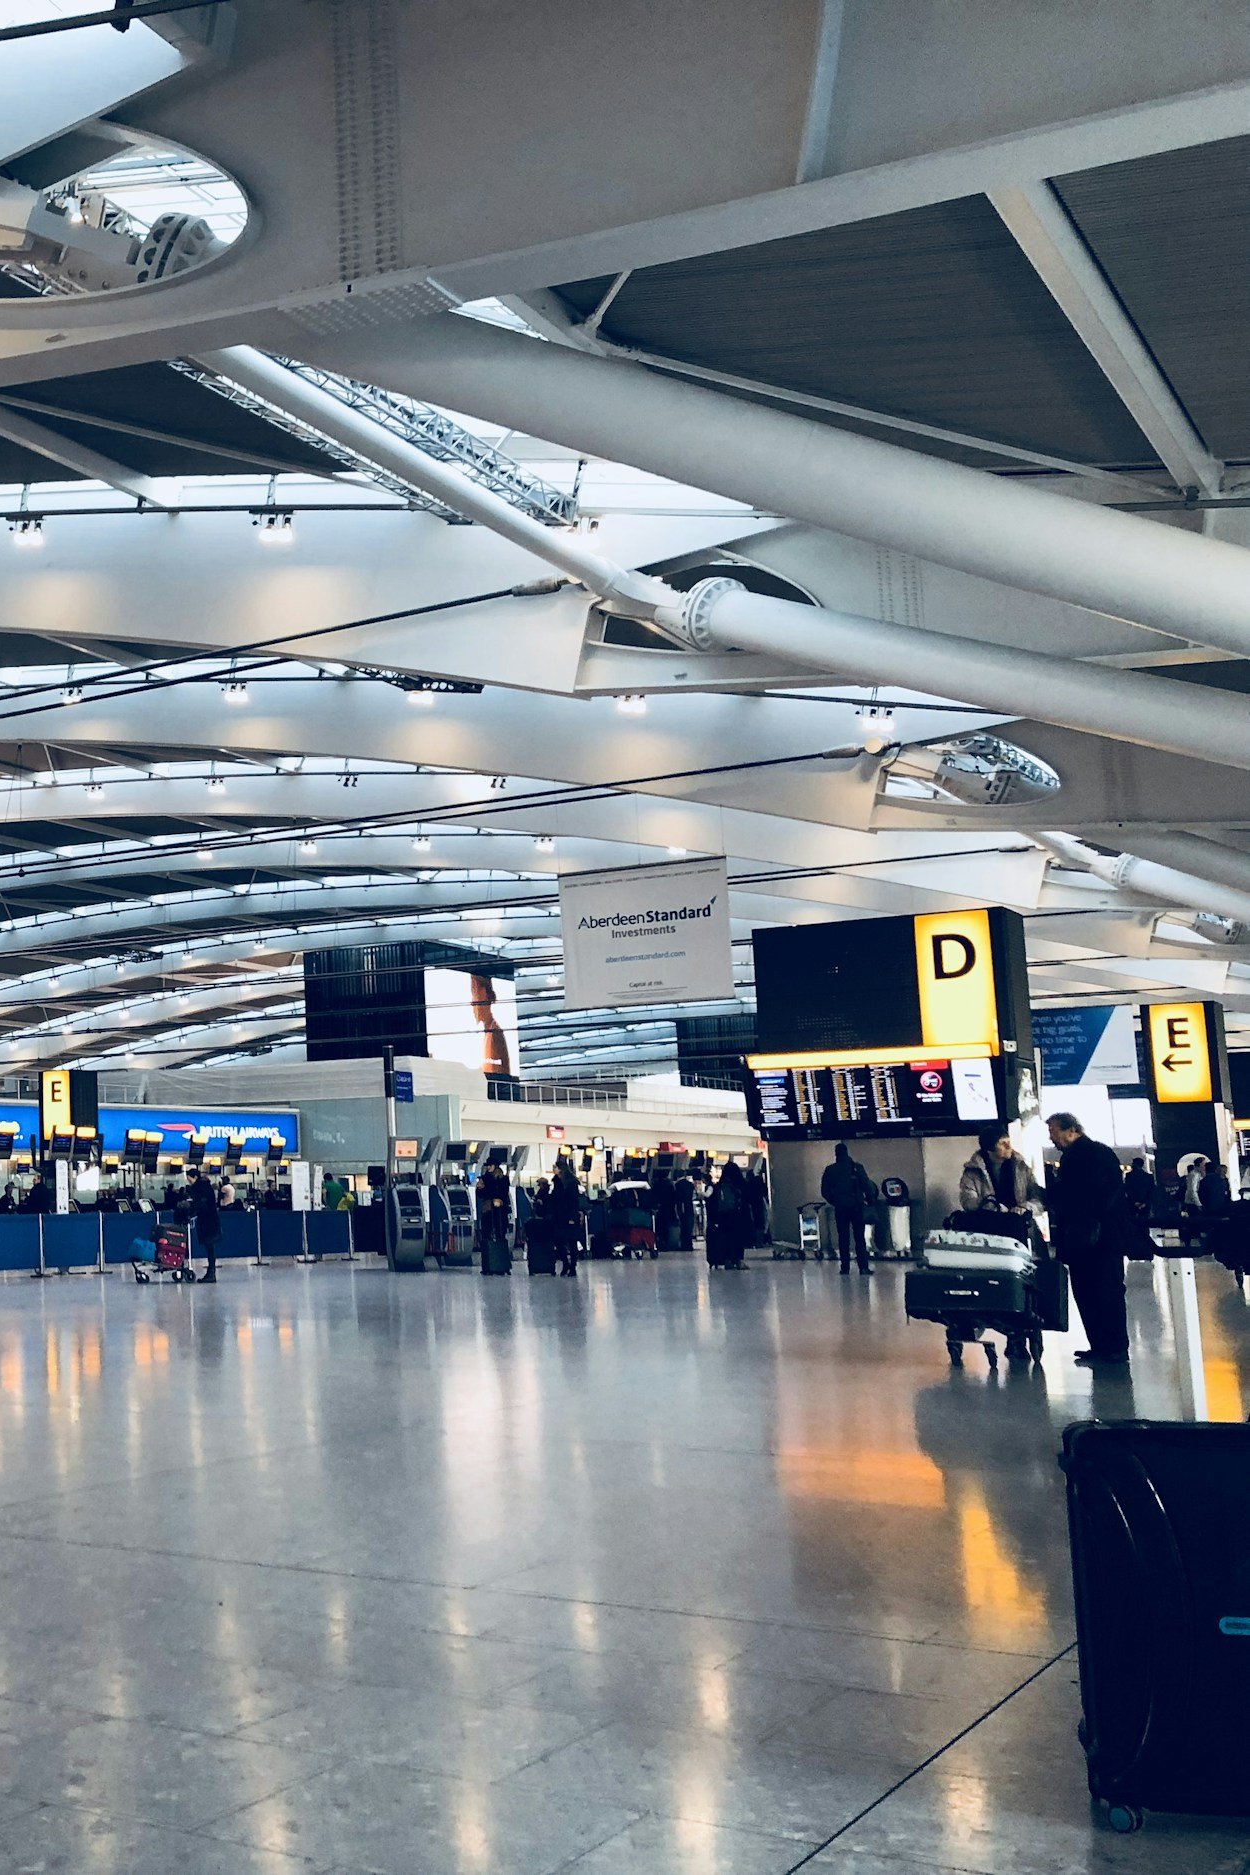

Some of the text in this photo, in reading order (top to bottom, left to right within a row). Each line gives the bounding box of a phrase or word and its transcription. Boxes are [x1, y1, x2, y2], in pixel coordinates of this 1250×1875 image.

[611, 925, 676, 939] Investments
[932, 934, 976, 980] D
[1166, 1017, 1192, 1049] E
[51, 1080, 63, 1102] E
